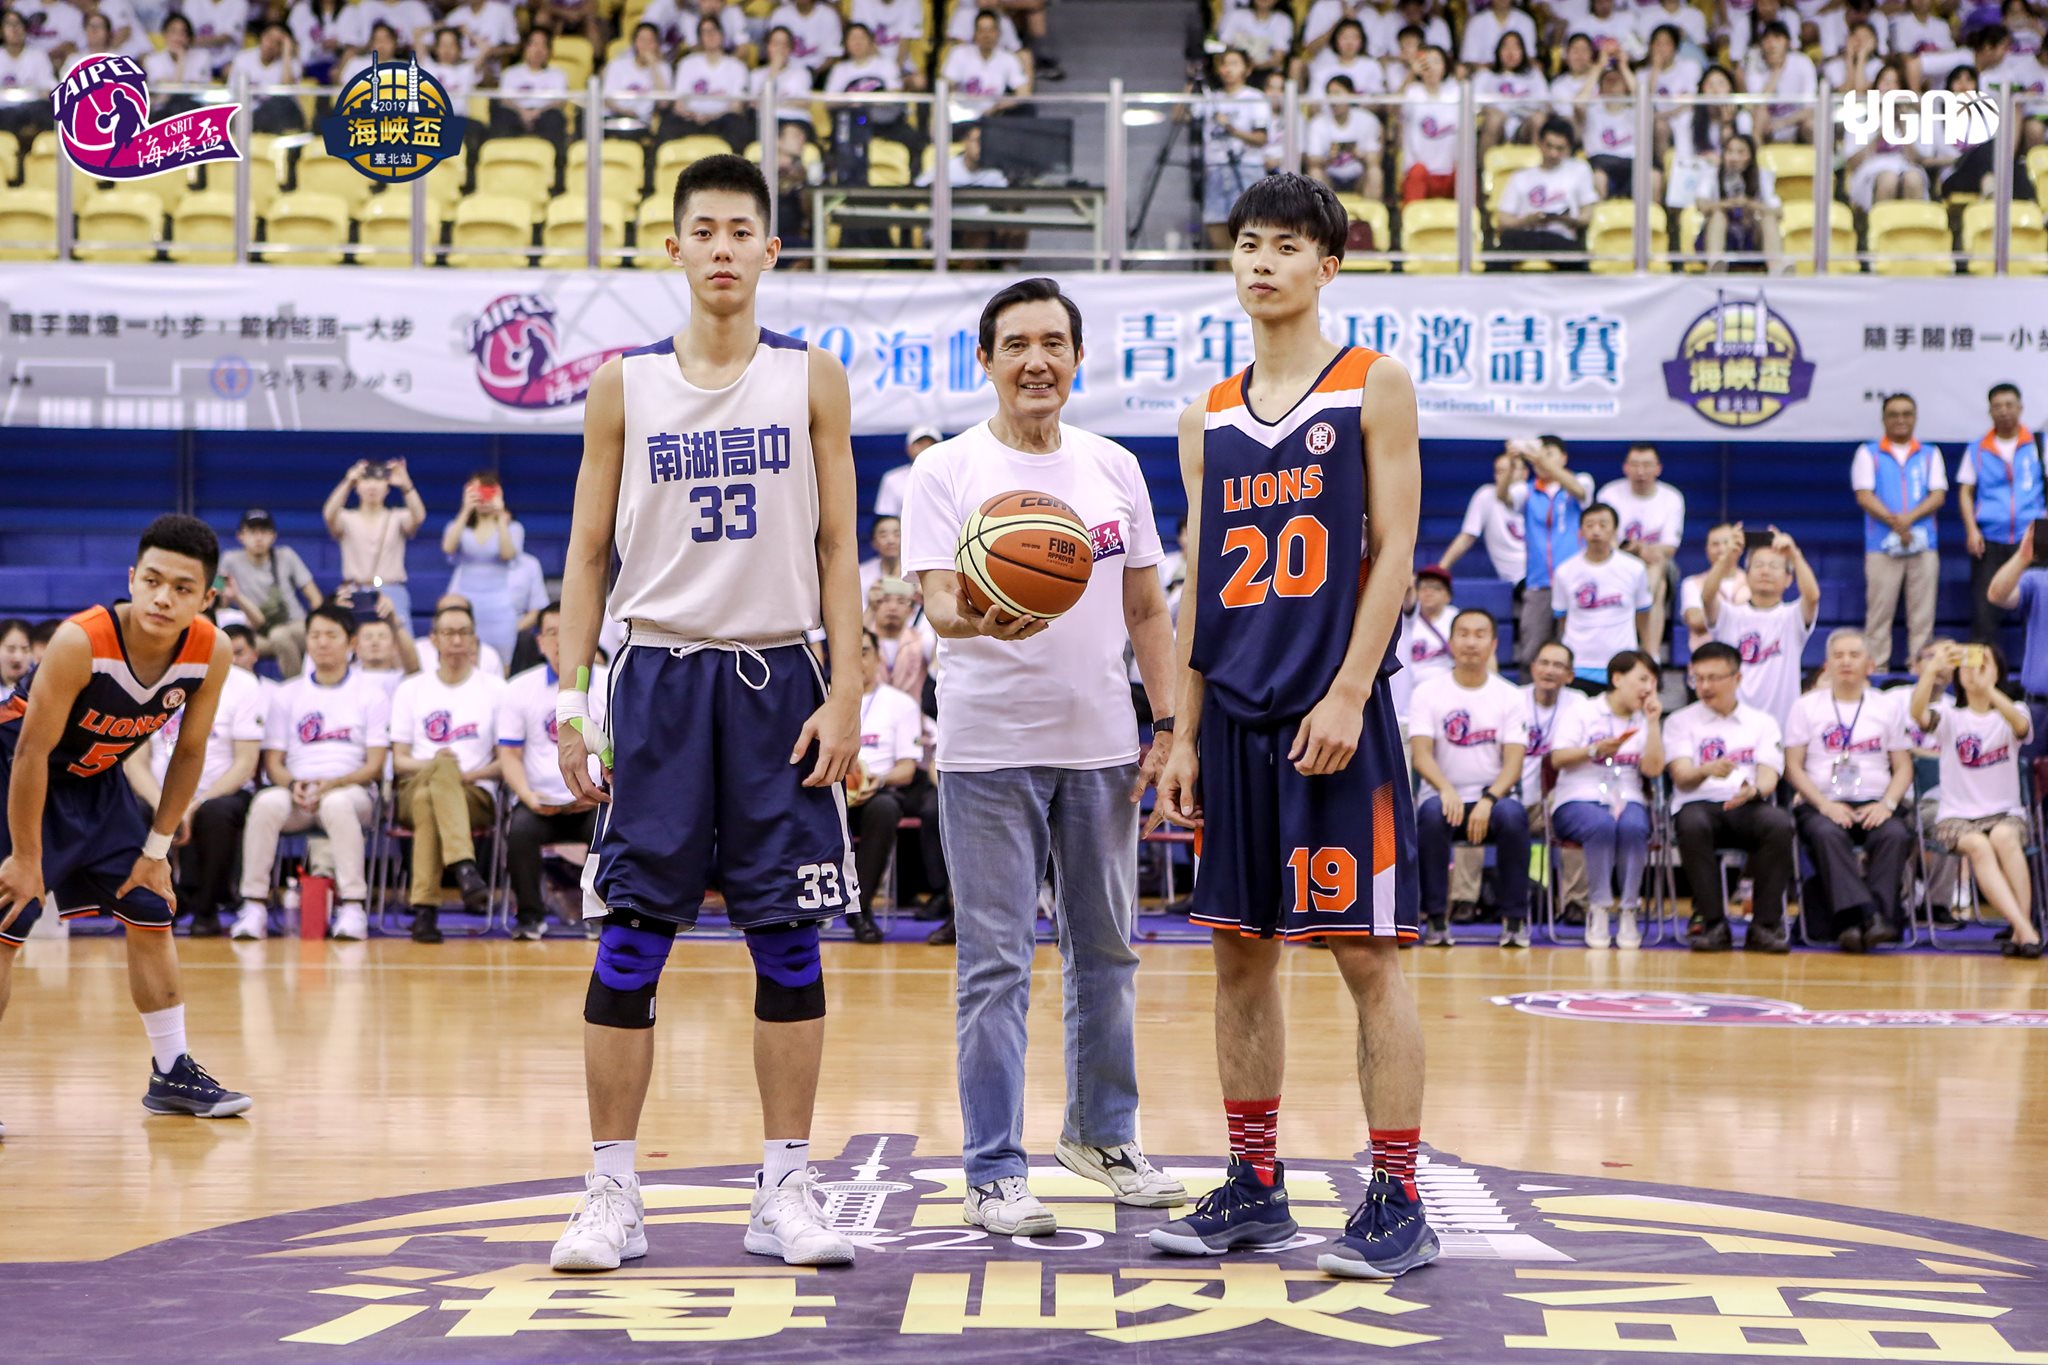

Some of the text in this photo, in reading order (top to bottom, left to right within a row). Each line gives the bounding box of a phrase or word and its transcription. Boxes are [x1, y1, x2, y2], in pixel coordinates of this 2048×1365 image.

[646, 424, 791, 485] 南湖高中
[689, 483, 758, 544] 33
[1222, 464, 1324, 514] LIONS
[1047, 551, 1076, 565] APPROVED
[1048, 536, 1076, 557] FIBA
[1218, 514, 1329, 610] 20
[78, 707, 168, 739] LIONS
[67, 741, 136, 778] 5
[797, 862, 843, 910] 33
[1287, 846, 1358, 914] 19
